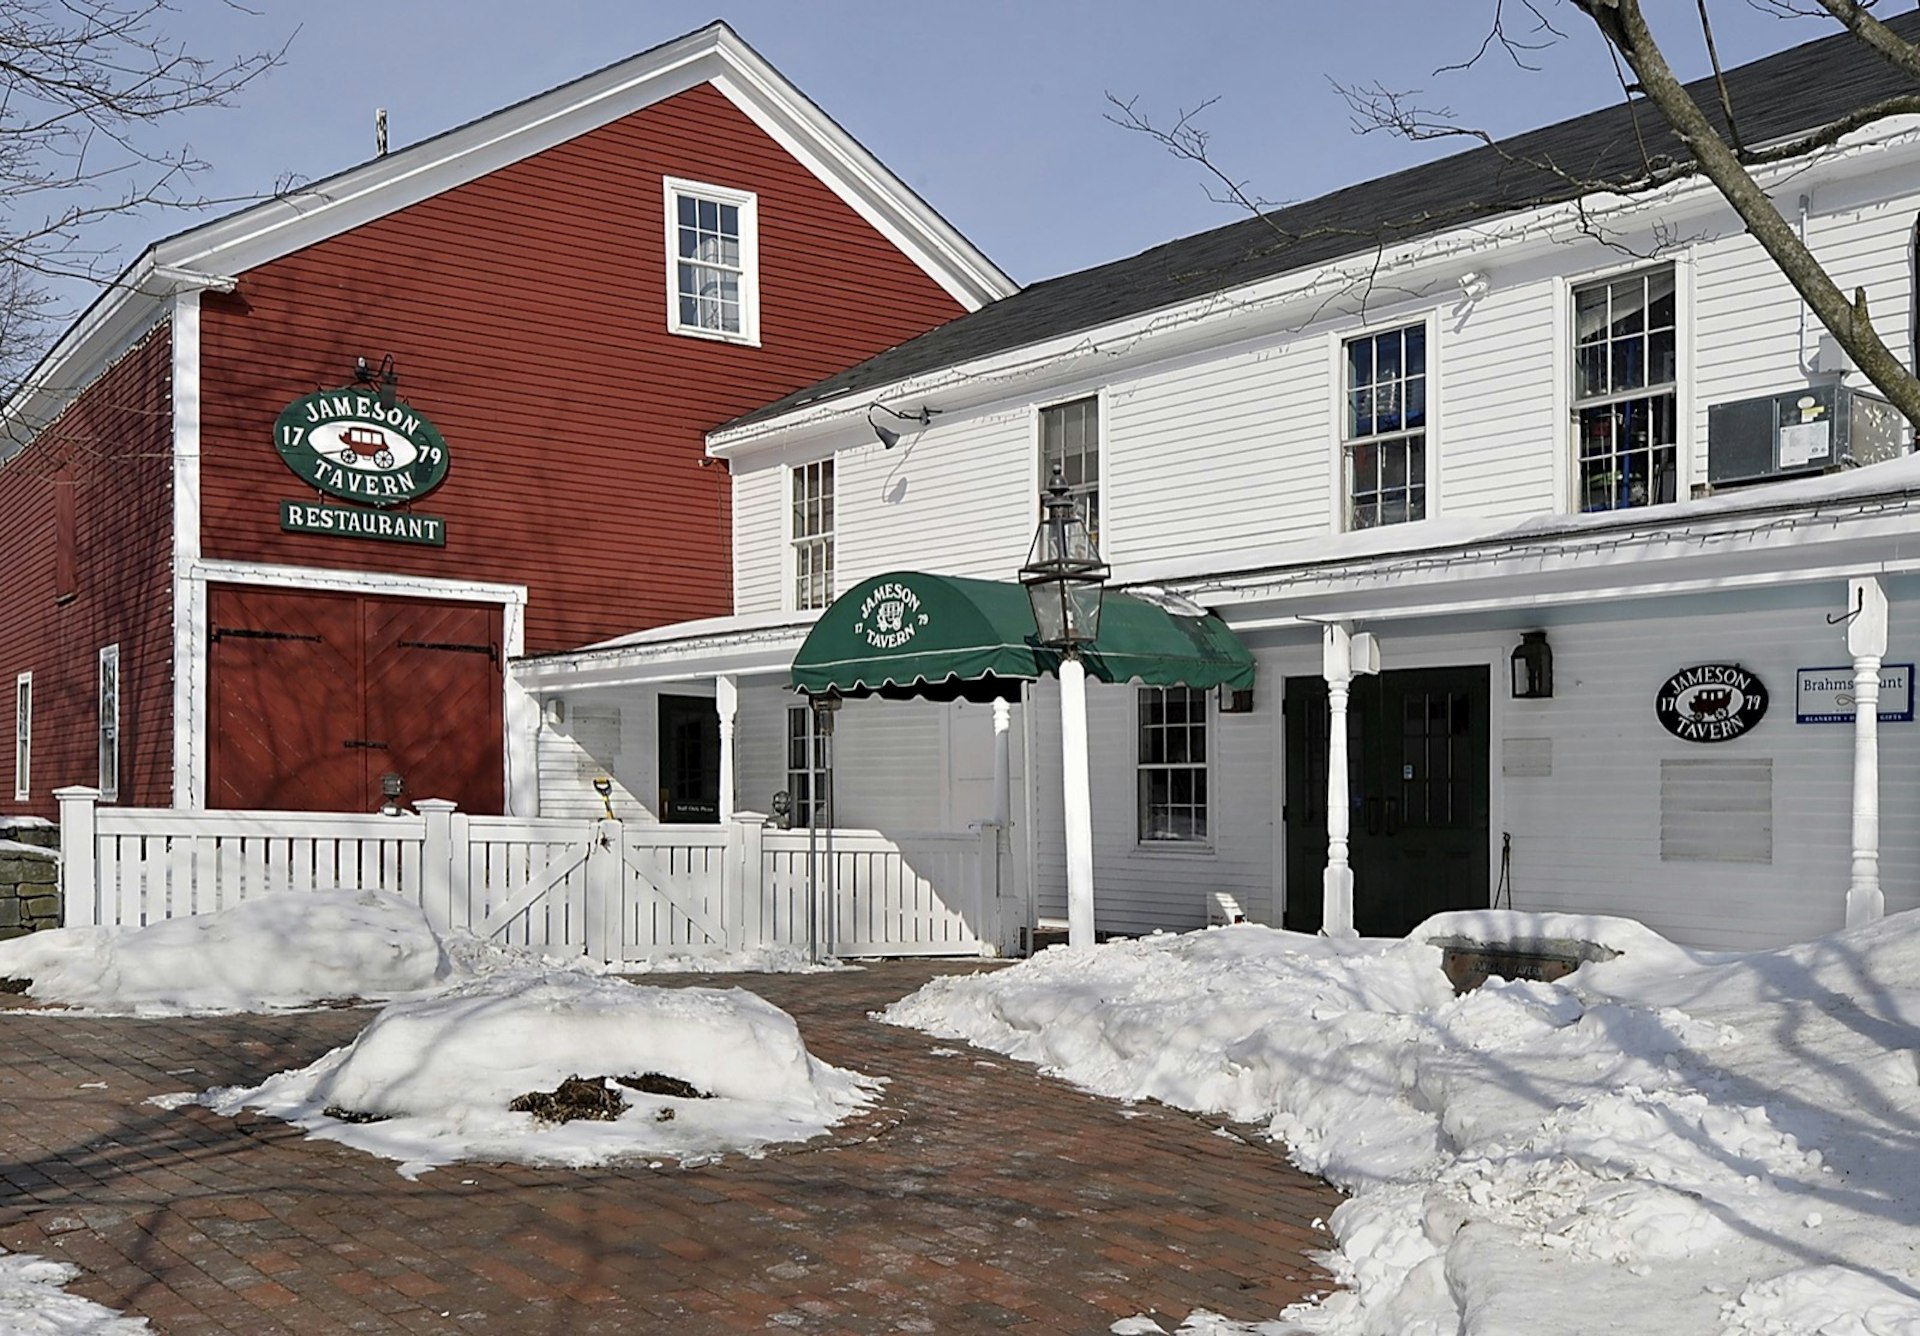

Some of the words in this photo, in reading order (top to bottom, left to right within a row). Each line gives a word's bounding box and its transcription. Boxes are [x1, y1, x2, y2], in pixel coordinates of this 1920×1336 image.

[306, 397, 420, 436] JAMESON
[283, 426, 304, 446] 17
[418, 446, 442, 465] 79
[314, 459, 416, 495] TAVERN
[288, 505, 439, 540] RESTAURANT
[861, 583, 921, 619] JAMESON
[917, 613, 929, 626] 79
[866, 623, 915, 649] TAVERN
[1671, 666, 1752, 695] JAMESON
[1803, 678, 1854, 691] Brahms
[1661, 697, 1675, 711] 17
[1745, 695, 1761, 710] 79
[1677, 714, 1745, 739] TAVERN
